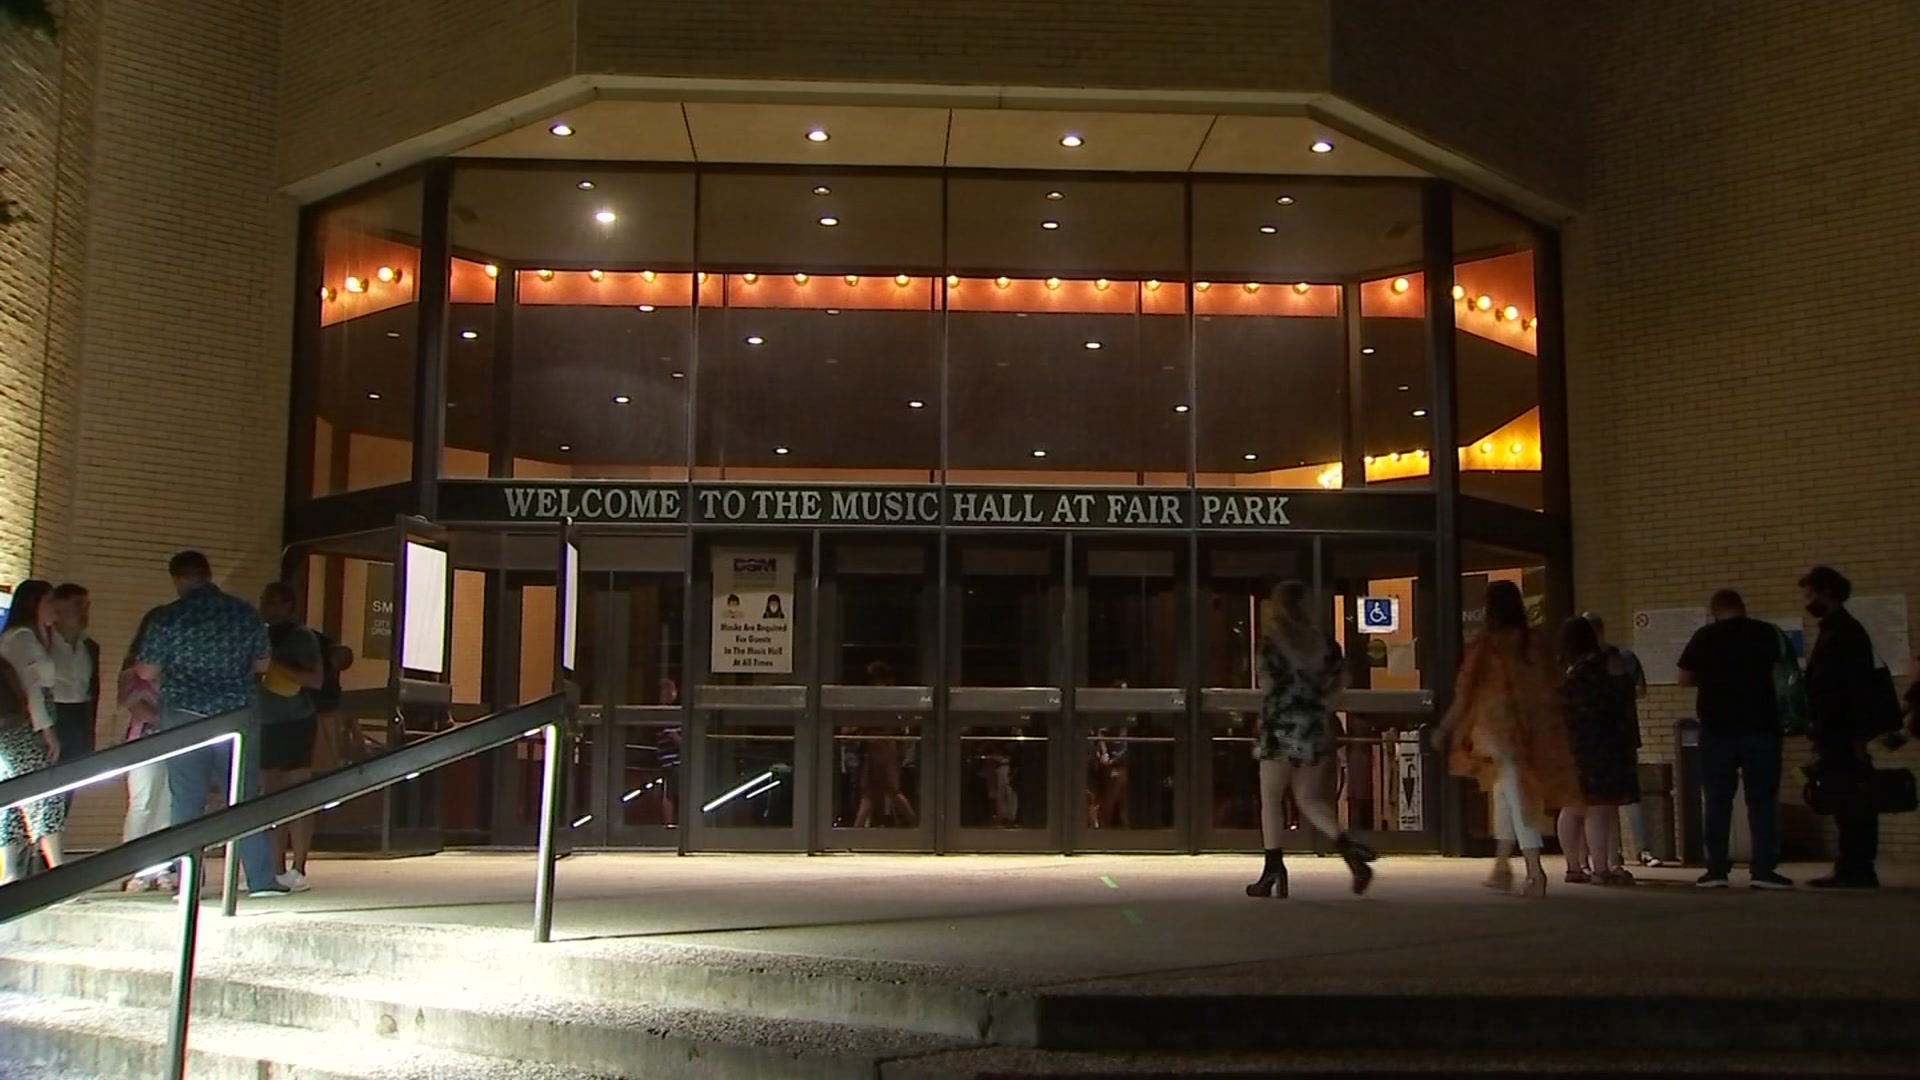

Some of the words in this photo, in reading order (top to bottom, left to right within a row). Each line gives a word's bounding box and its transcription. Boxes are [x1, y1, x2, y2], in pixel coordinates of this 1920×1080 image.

[504, 489, 680, 520] WELCOME
[699, 490, 746, 520] TO
[752, 490, 820, 522] THE
[830, 491, 940, 523] MUSIC
[951, 492, 1043, 523] HALL
[1051, 494, 1096, 524] AT
[1106, 495, 1183, 525] FAIR
[1201, 496, 1291, 526] PARK
[720, 623, 742, 632] Masks
[744, 623, 755, 632] Are
[757, 623, 787, 632] Required
[735, 635, 747, 643] For
[748, 635, 771, 643] Guests
[724, 646, 732, 655] In
[733, 646, 745, 655] The
[747, 646, 766, 655] Music
[768, 646, 783, 655] Hall
[732, 658, 741, 666] At
[742, 658, 752, 666] All
[753, 658, 773, 667] Times
